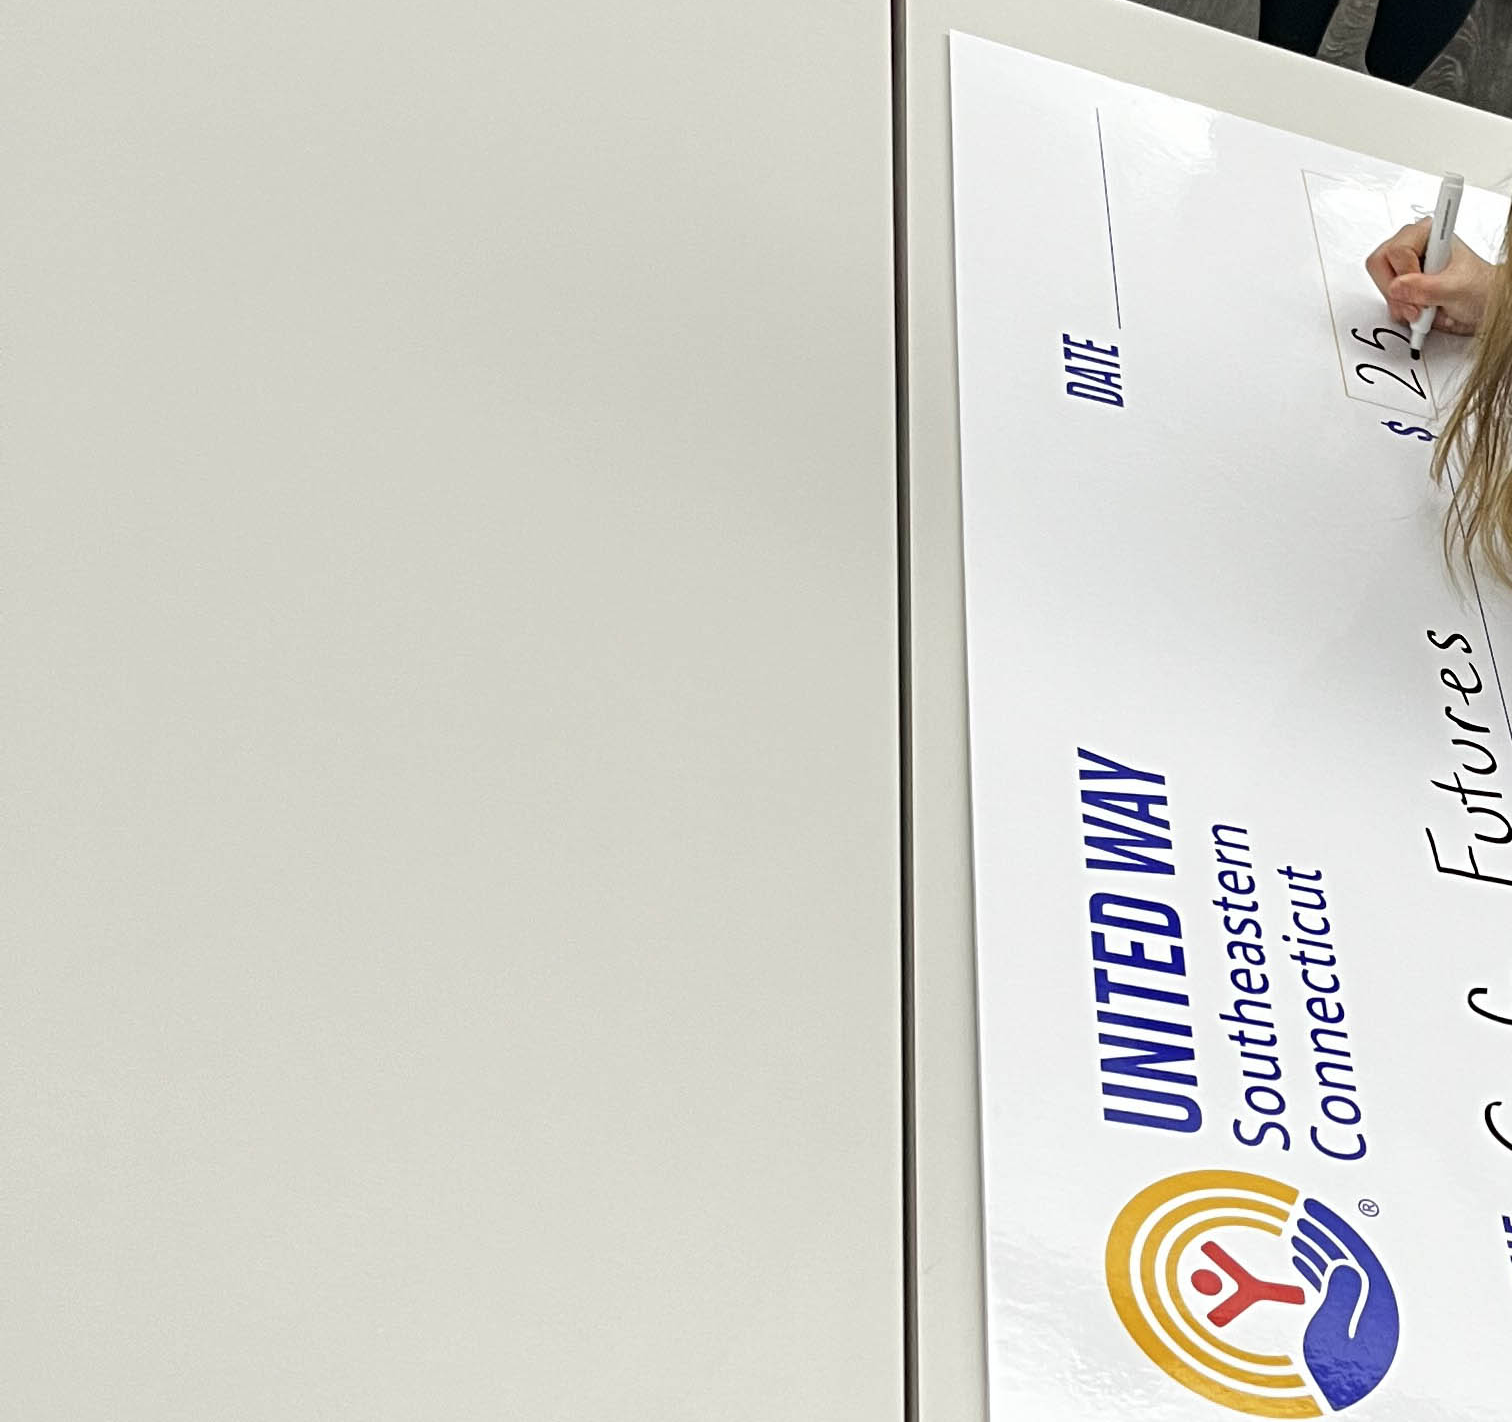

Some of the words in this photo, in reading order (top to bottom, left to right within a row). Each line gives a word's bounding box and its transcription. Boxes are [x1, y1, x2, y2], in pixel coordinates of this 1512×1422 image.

[1062, 333, 1124, 408] DATE
[1378, 419, 1441, 443] $
[1076, 747, 1176, 876] WAY
[1088, 892, 1203, 1133] UNITED
[1211, 824, 1291, 1152] Southeastern
[1276, 865, 1367, 1161] Connecticut
